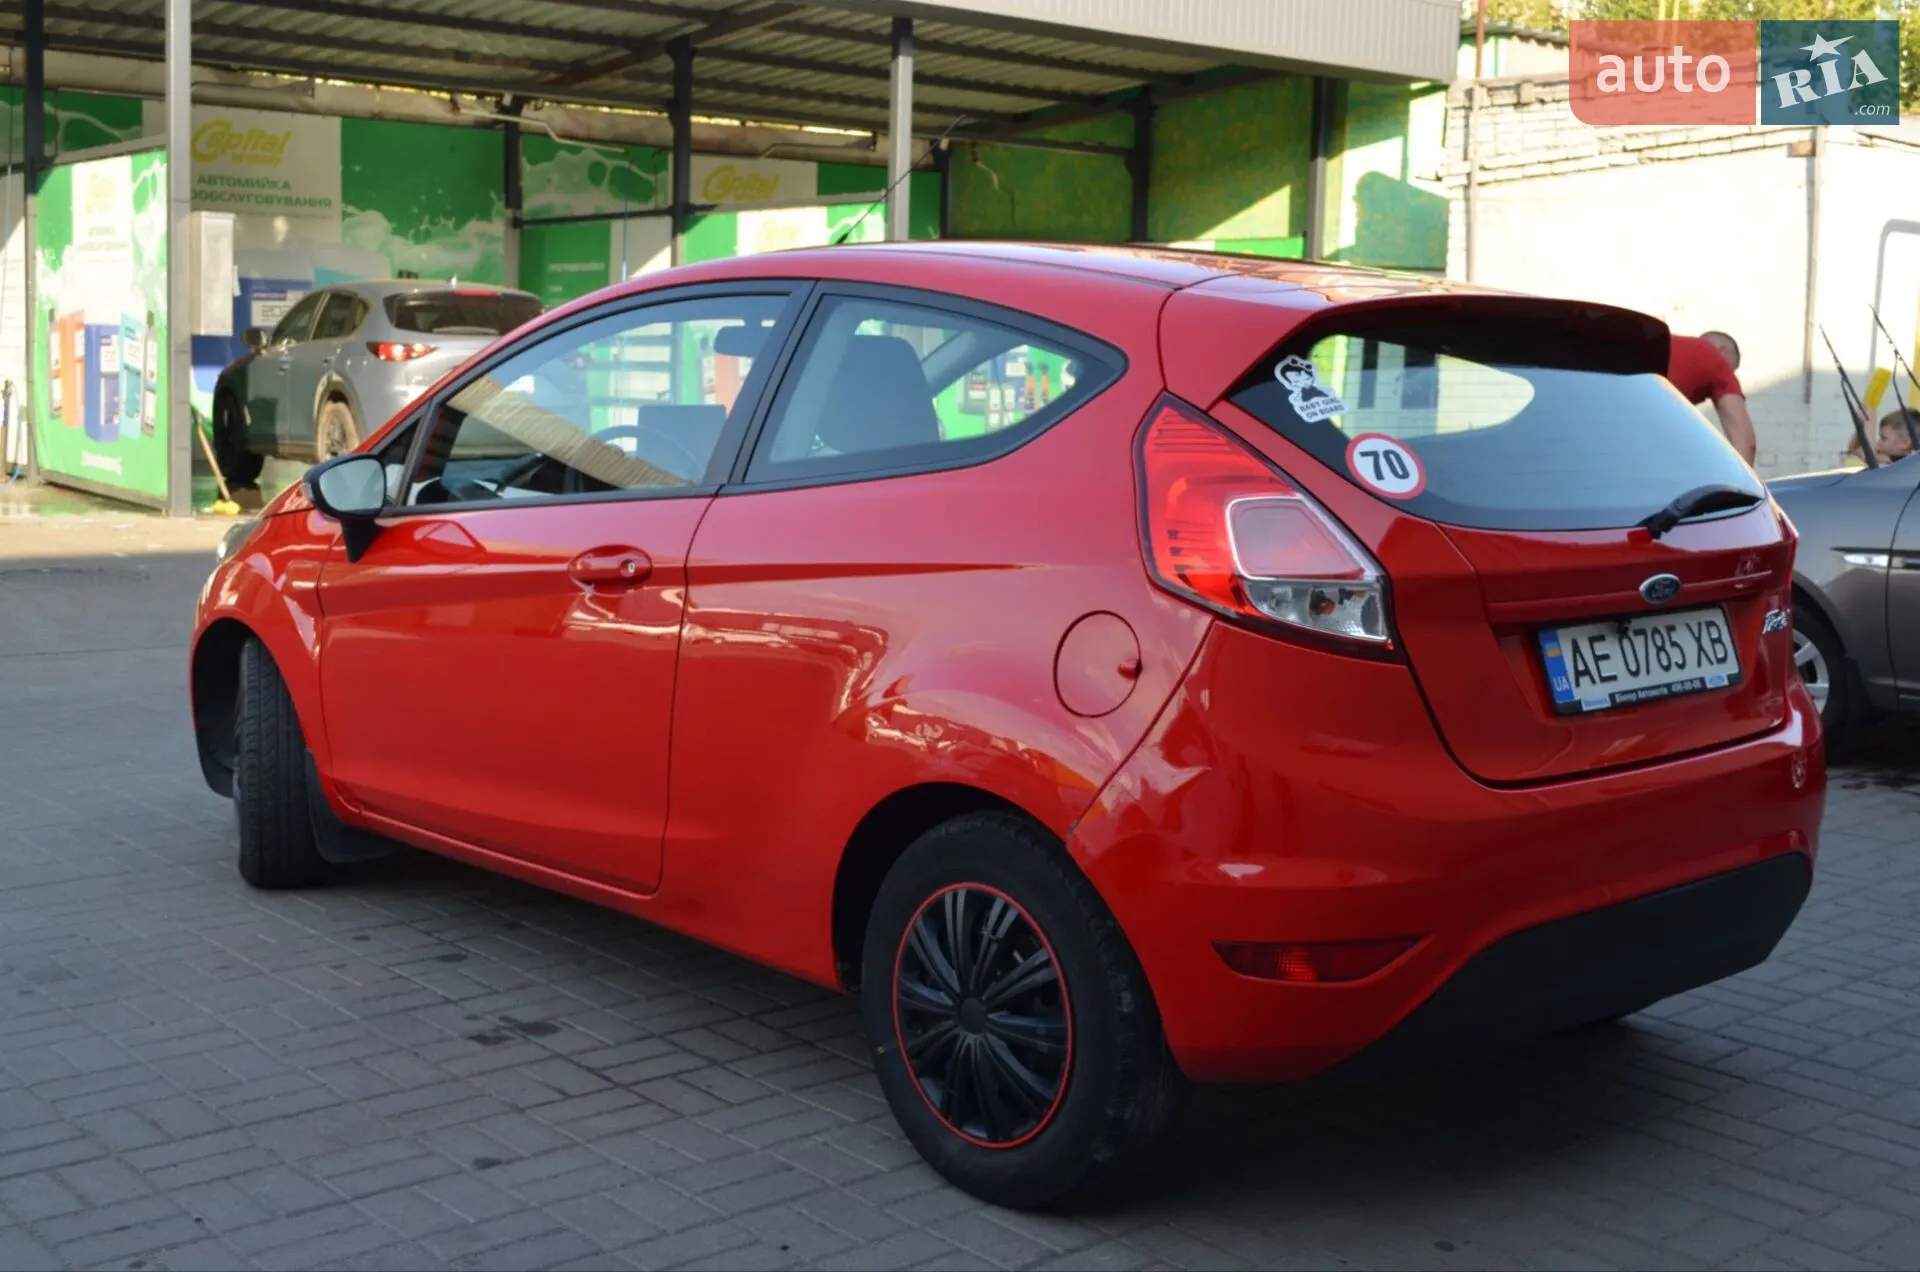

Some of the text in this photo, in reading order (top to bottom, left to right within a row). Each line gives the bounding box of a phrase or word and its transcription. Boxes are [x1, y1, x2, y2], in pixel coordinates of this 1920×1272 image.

[197, 175, 292, 191] АВТОМИЙКА
[1299, 401, 1320, 413] BABY
[1306, 404, 1345, 419] ON BOARD
[1359, 449, 1410, 481] 70
[1572, 620, 1728, 687] AE 0785 XB
[1553, 677, 1570, 692] UA
